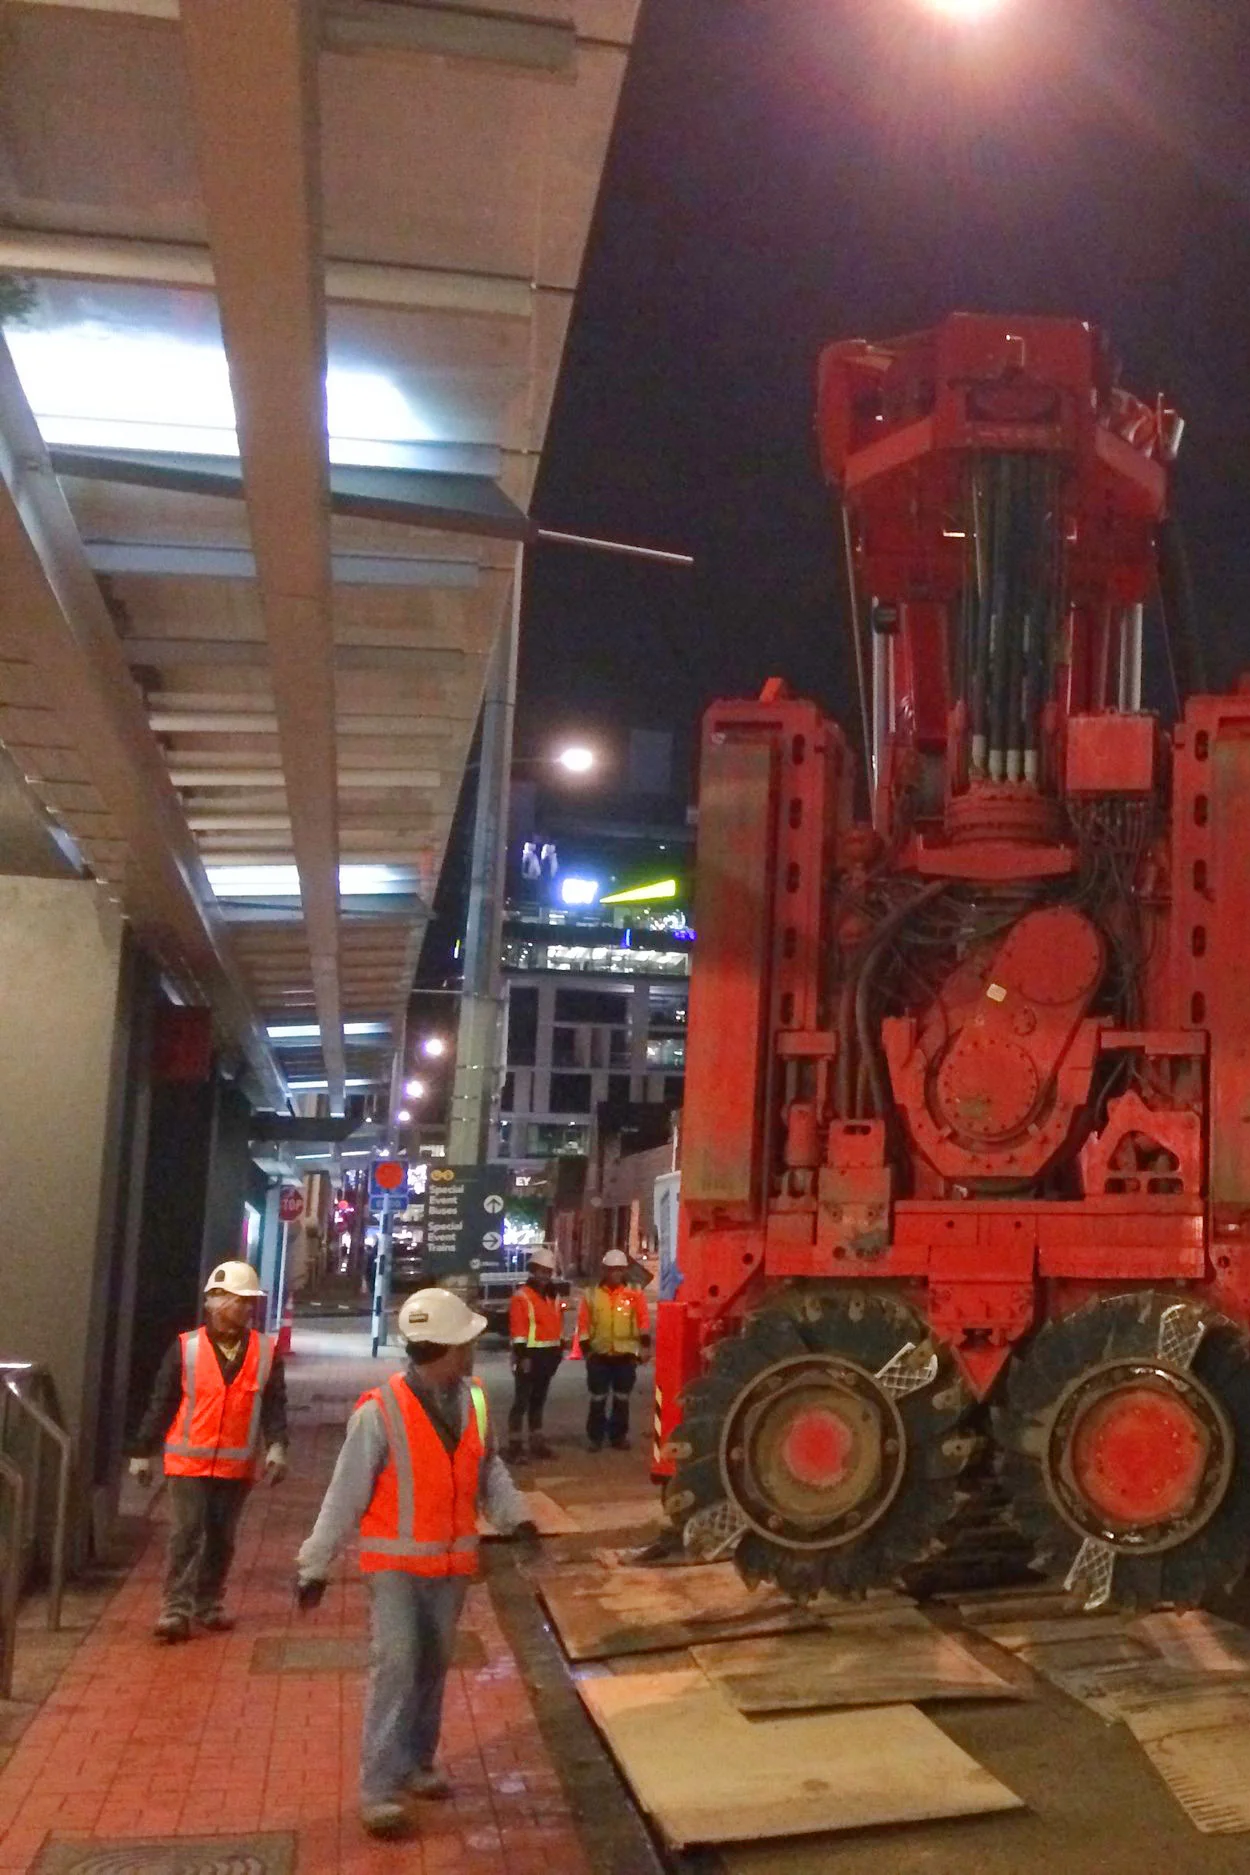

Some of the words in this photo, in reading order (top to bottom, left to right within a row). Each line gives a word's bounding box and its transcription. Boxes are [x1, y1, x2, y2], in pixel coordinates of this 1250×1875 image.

[515, 1176, 531, 1187] EY
[428, 1184, 465, 1195] Special
[428, 1195, 458, 1205] Event
[428, 1205, 458, 1215] Buses
[427, 1221, 464, 1232] Special
[427, 1232, 457, 1242] Event
[426, 1242, 457, 1252] Trains
